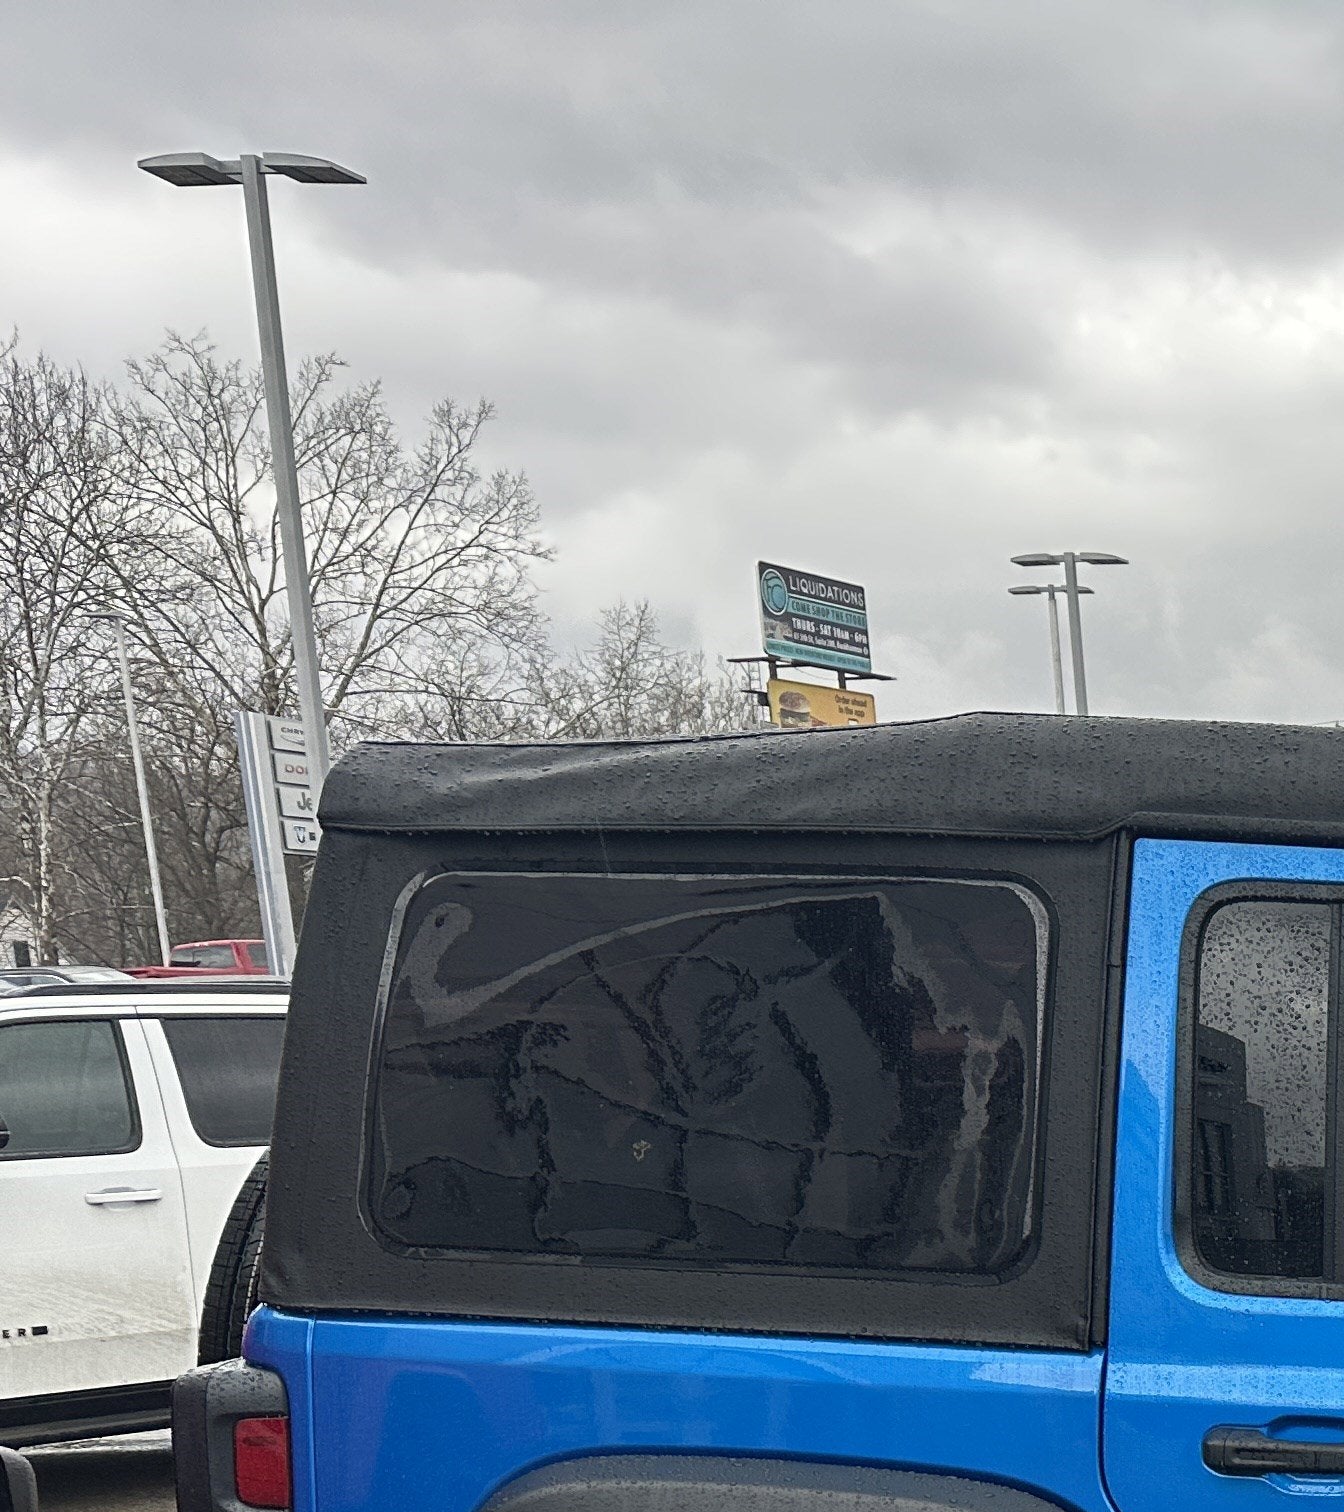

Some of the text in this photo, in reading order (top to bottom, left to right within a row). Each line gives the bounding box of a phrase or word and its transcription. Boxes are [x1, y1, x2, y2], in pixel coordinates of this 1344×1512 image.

[789, 575, 864, 606] LIQUIDATIONS
[792, 600, 811, 613] COME
[812, 604, 830, 617] SHOP
[831, 609, 844, 621] THE
[792, 617, 815, 632] THURS
[820, 623, 831, 636] SAT
[281, 726, 303, 735] CHRY
[285, 764, 308, 775] DO
[297, 792, 313, 812] Je
